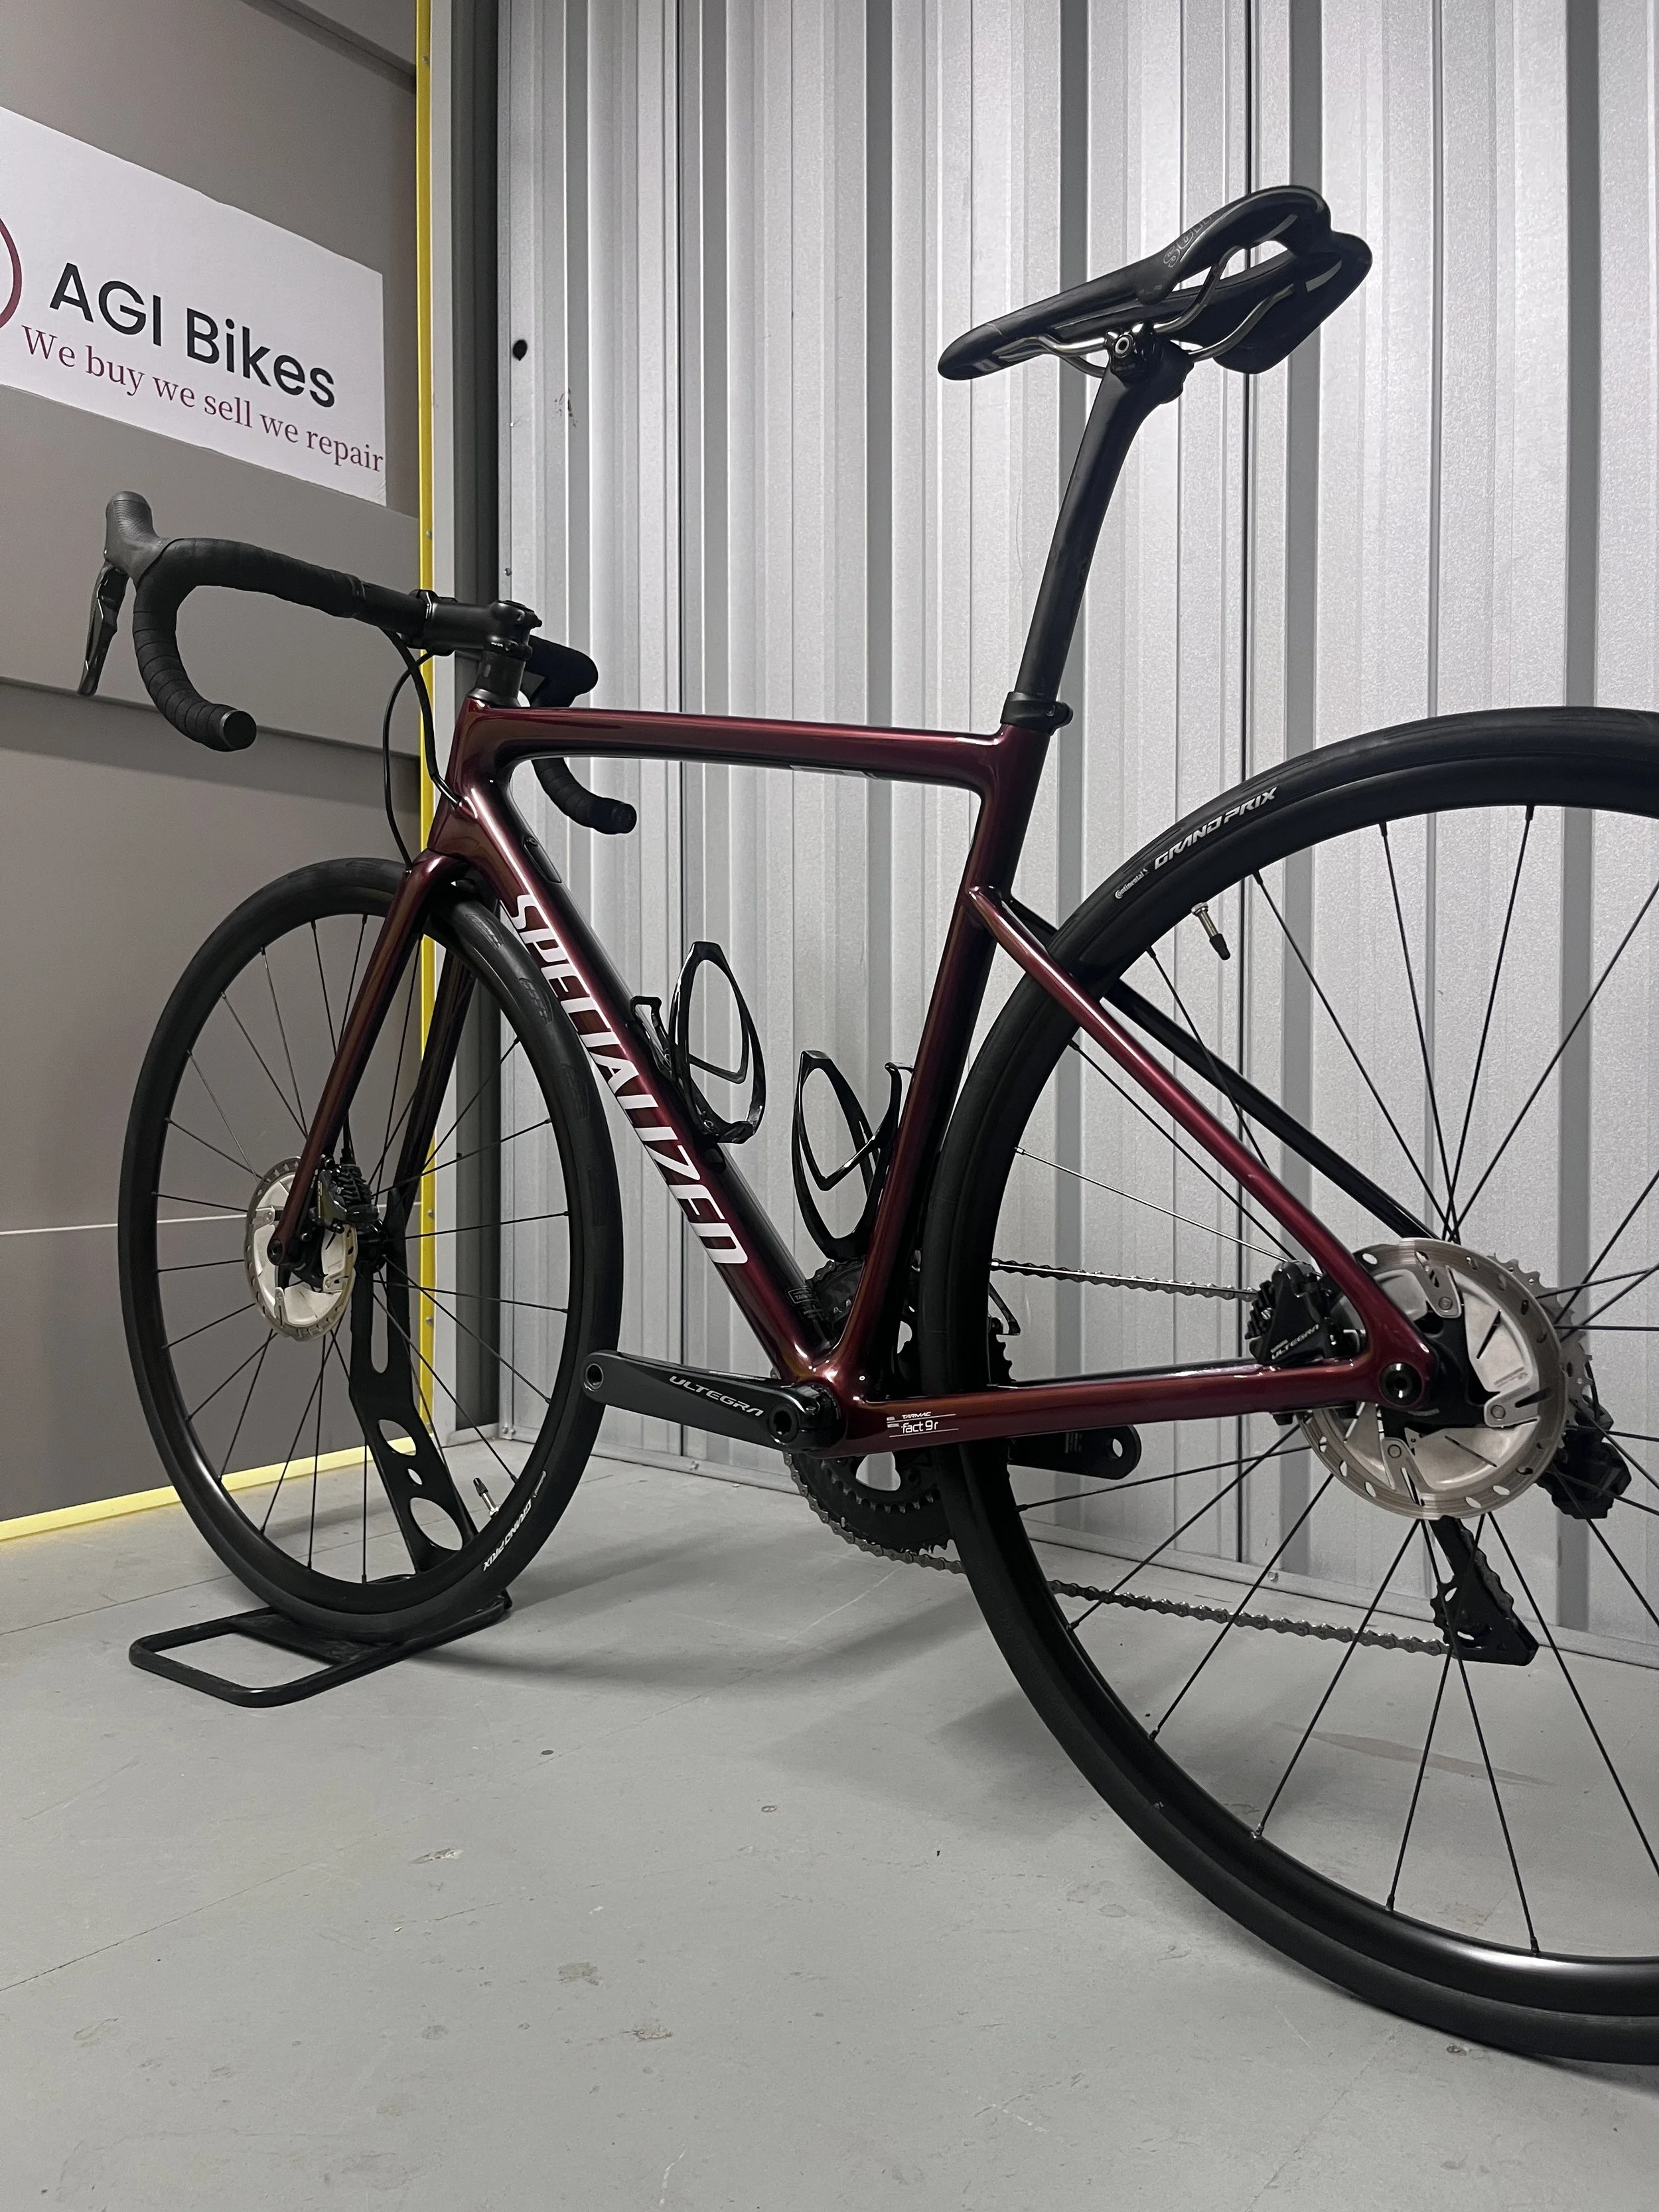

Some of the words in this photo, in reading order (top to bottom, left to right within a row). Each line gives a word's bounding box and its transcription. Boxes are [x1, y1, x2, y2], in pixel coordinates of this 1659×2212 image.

[49, 262, 162, 346] AGI
[186, 307, 335, 408] Bikes
[22, 325, 76, 368] We
[86, 344, 145, 396] buy
[153, 375, 196, 407] we
[204, 394, 252, 428] sell
[260, 414, 299, 443] we
[307, 429, 384, 473] repair
[1154, 819, 1222, 870] GRAND
[1223, 787, 1277, 824] PRIX
[505, 894, 748, 1264] SPECIALIZED
[669, 1375, 764, 1417] ULTEGRA
[901, 1421, 924, 1434] fact
